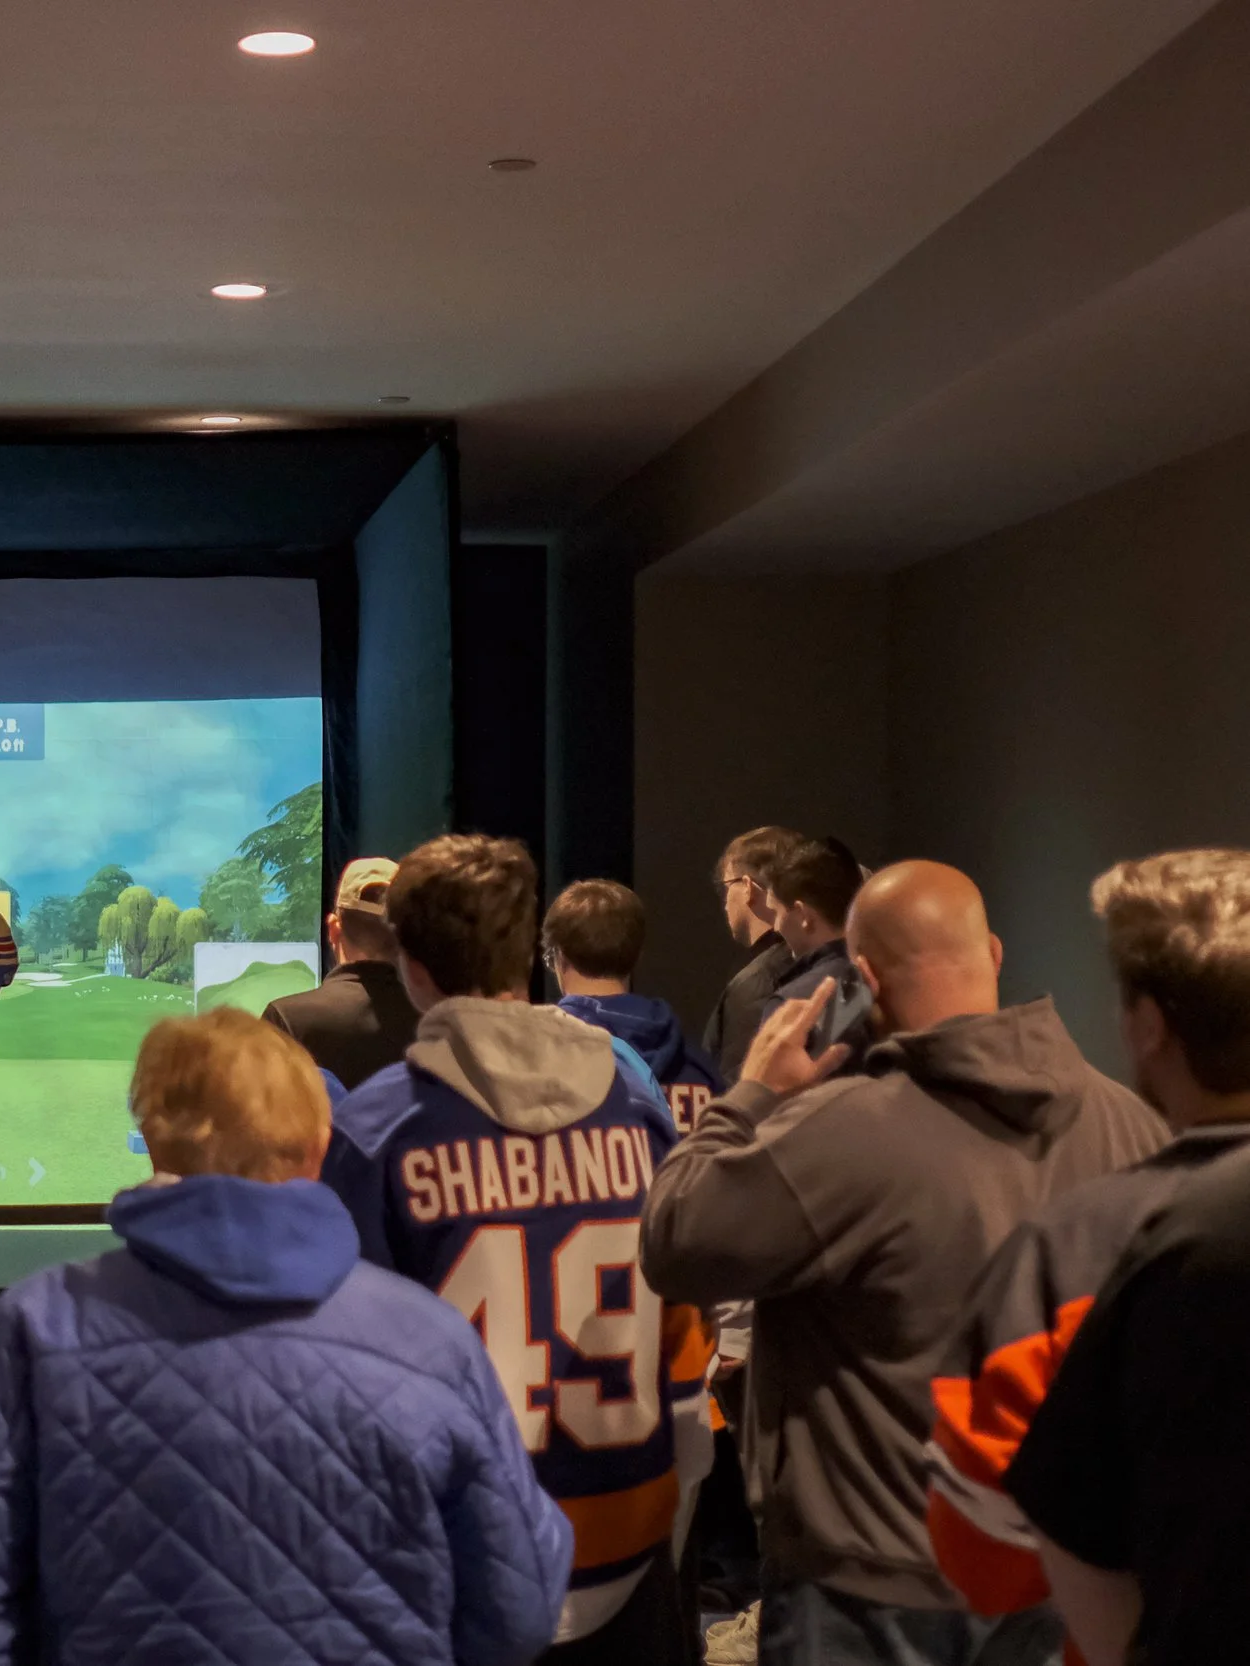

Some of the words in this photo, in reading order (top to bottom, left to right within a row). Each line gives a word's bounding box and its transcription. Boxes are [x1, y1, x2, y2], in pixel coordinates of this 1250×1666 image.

[13, 739, 25, 753] ft
[401, 1126, 654, 1224] SHABANOV
[436, 1217, 663, 1453] 49
